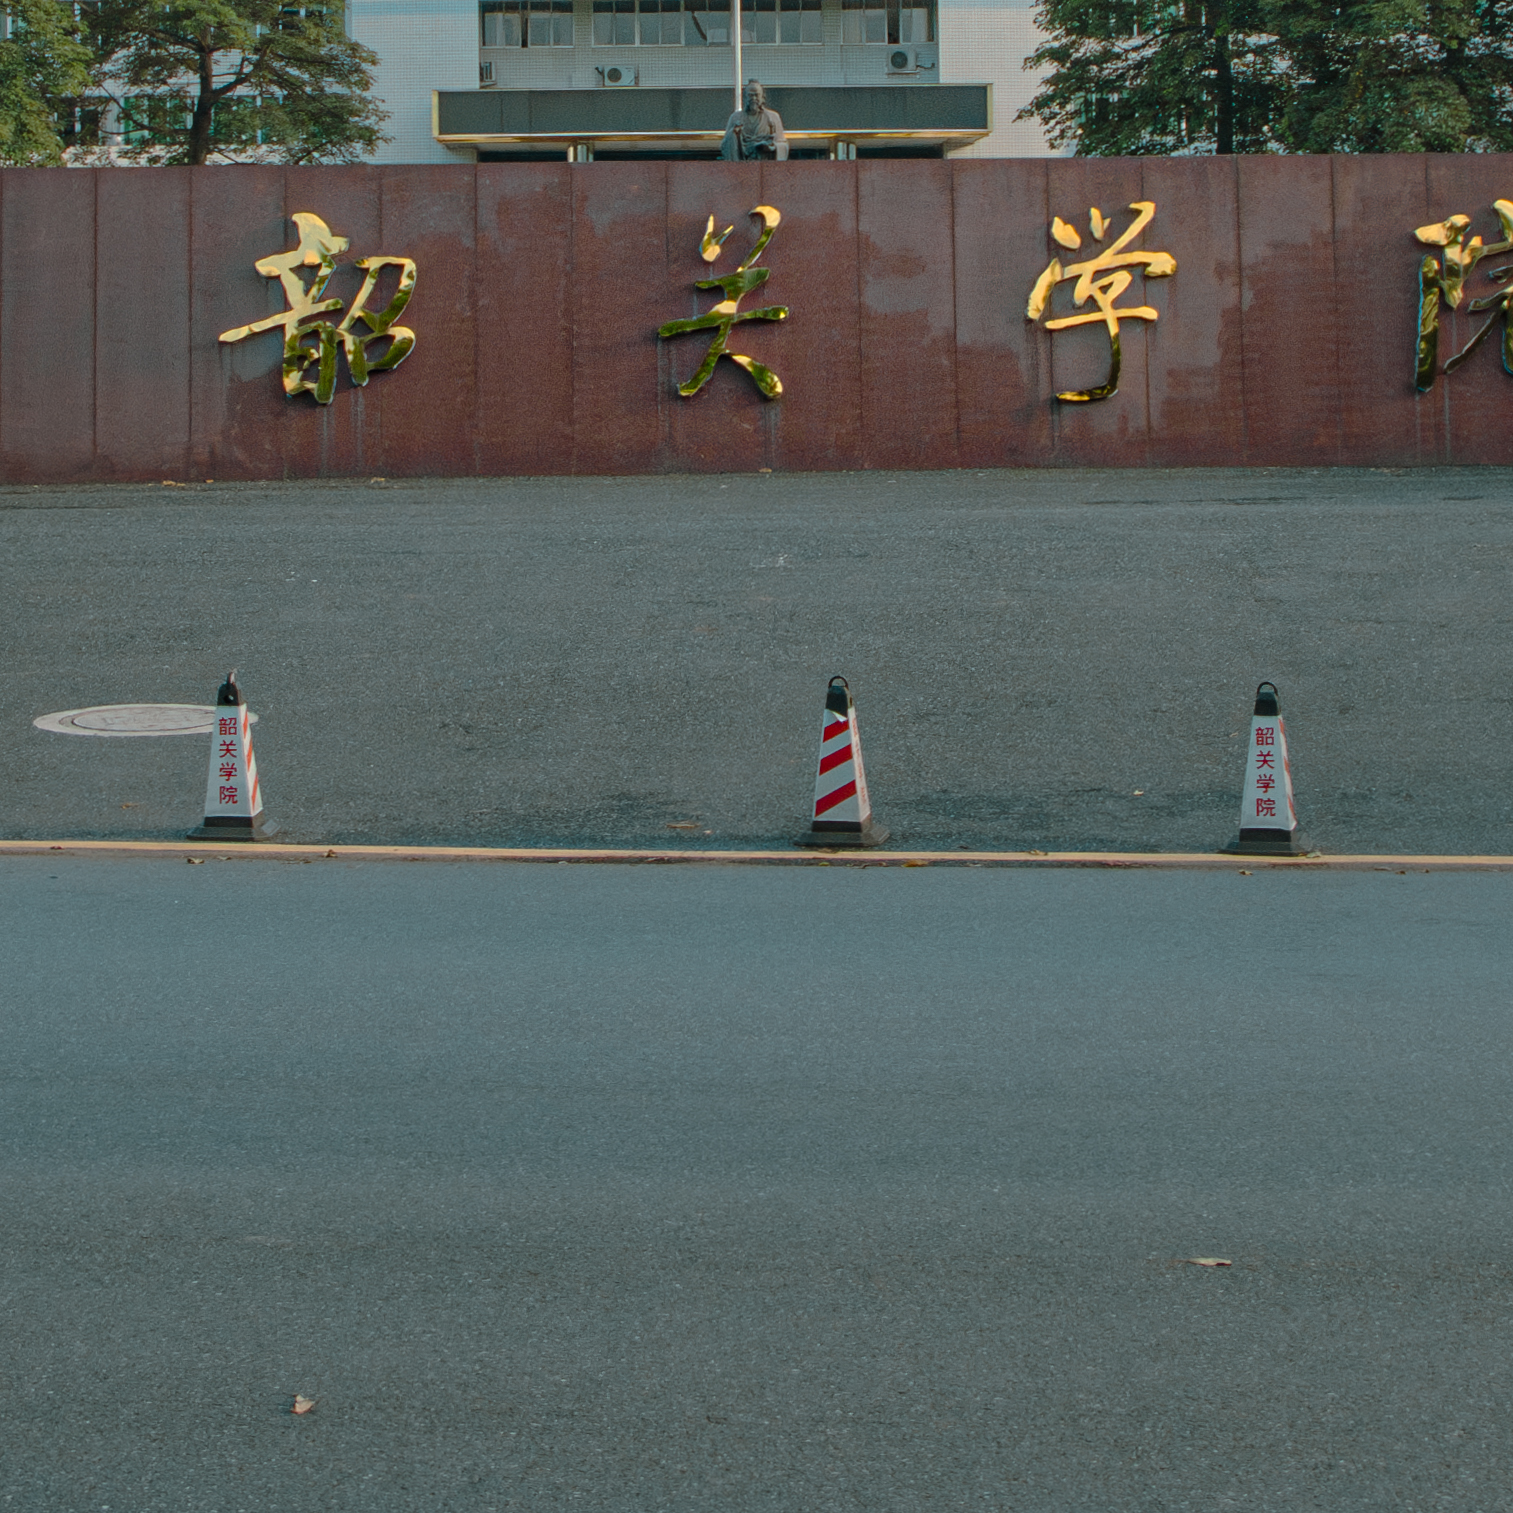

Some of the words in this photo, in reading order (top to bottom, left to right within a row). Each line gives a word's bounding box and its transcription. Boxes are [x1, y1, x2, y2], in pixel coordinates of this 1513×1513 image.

[219, 717, 238, 804] 韶关学院
[1255, 727, 1276, 817] 韶关学院
